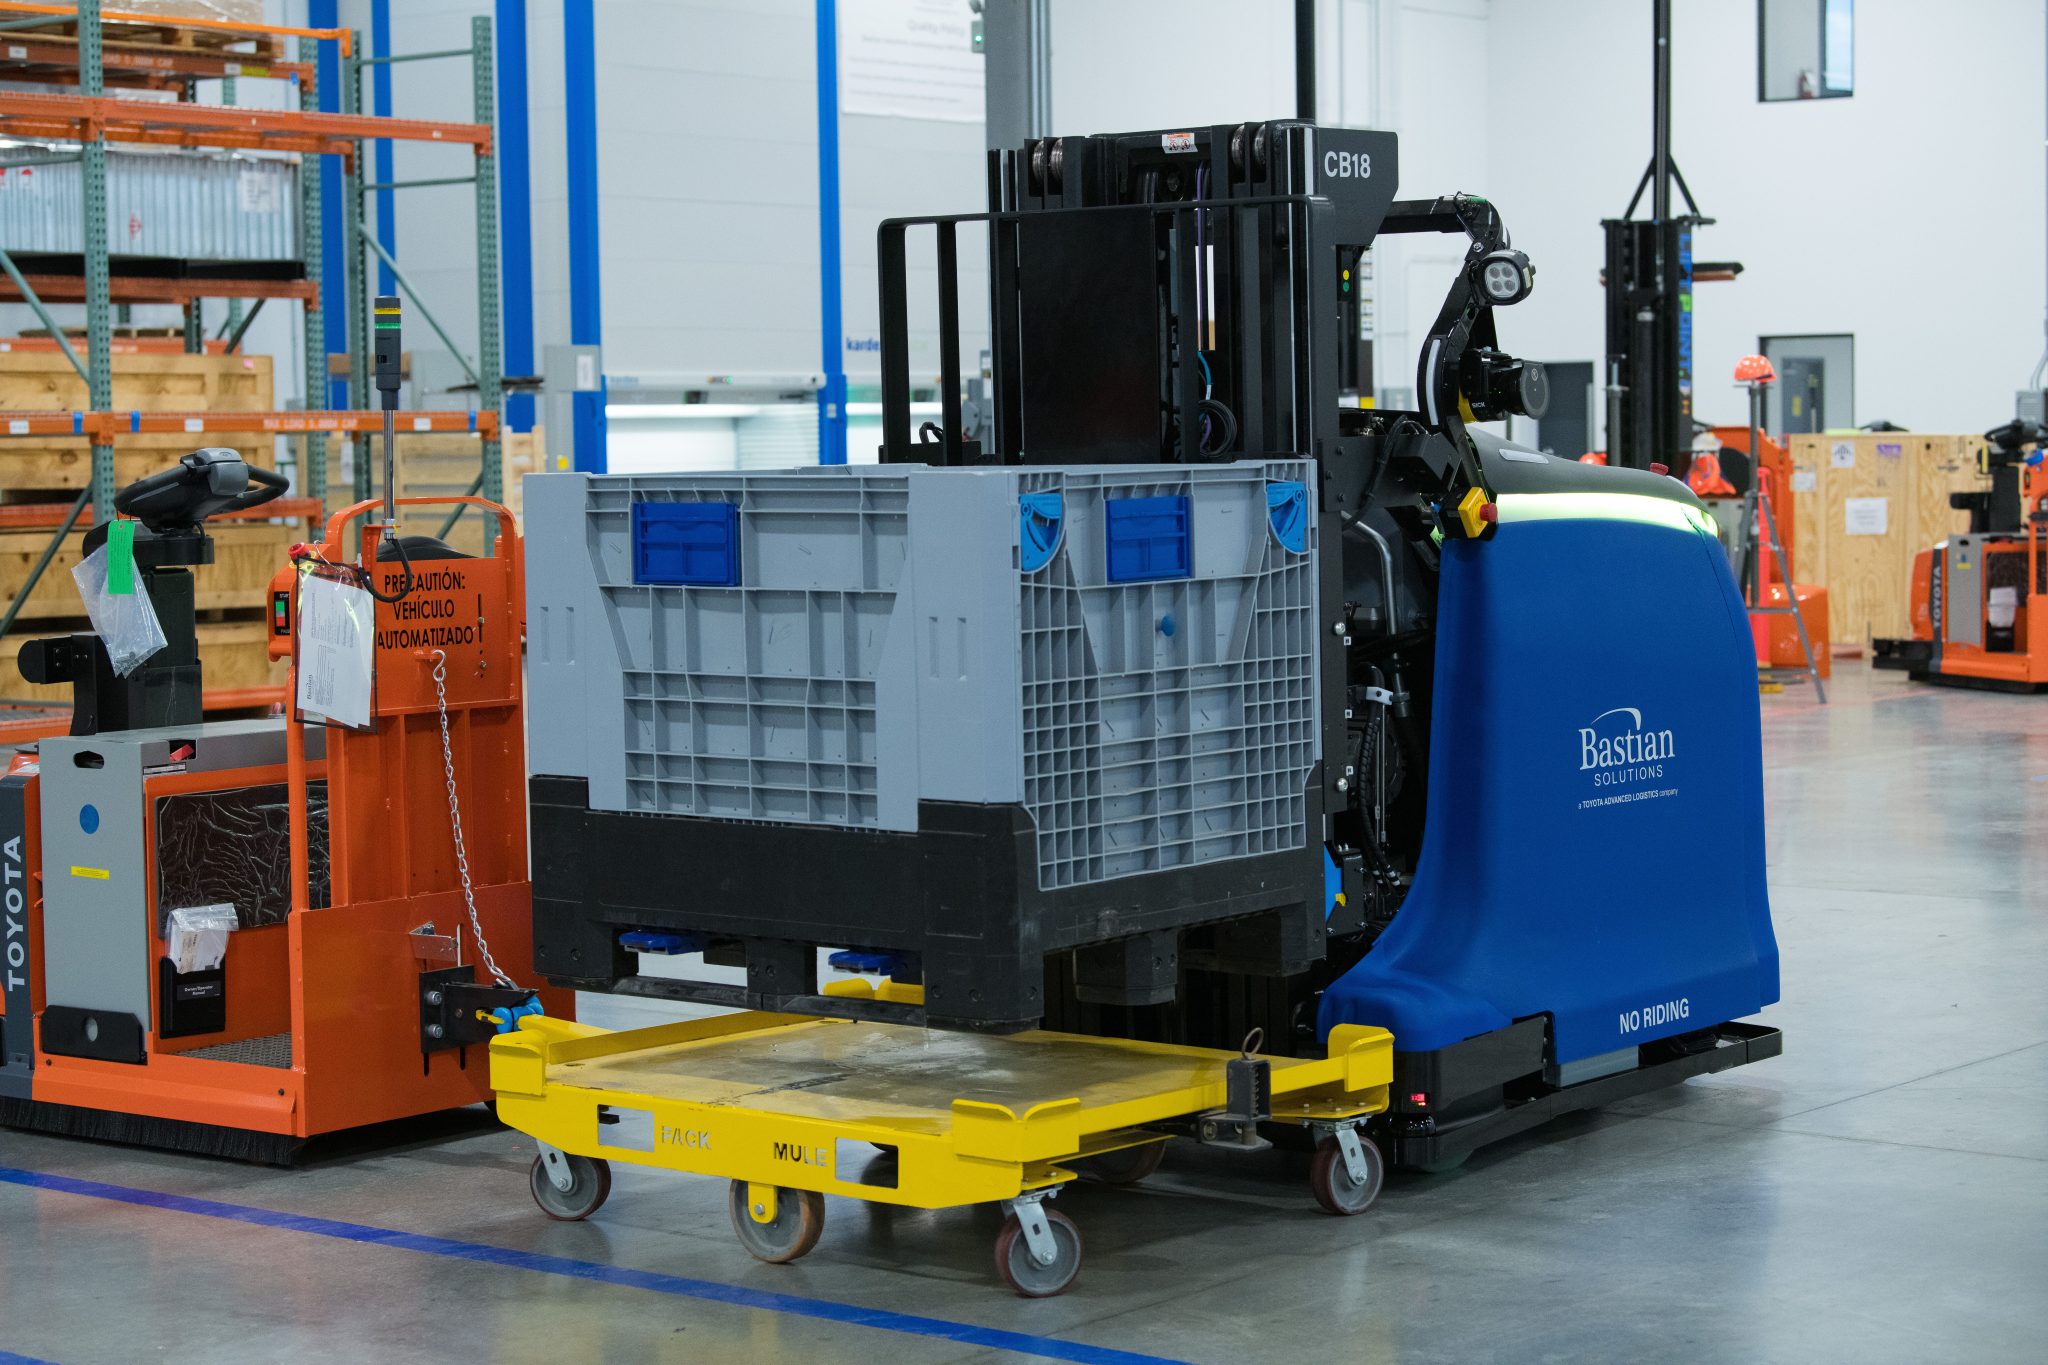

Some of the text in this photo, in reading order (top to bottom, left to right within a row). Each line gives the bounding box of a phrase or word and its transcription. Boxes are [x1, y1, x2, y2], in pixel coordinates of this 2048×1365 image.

[1324, 150, 1371, 179] CB18
[845, 336, 881, 352] karde
[1471, 401, 1486, 409] SICK
[392, 595, 455, 620] VEHÍCULO
[1932, 565, 1941, 629] TOYOTA
[377, 625, 474, 650] AUTOMATIZADO
[1578, 728, 1676, 771] Bastian
[1594, 764, 1663, 787] SOLUTIONS
[1582, 798, 1604, 809] TOYOTA
[1604, 794, 1632, 805] ADVANCED
[1632, 789, 1659, 801] LOGISTICS
[1659, 788, 1679, 797] company
[3, 835, 26, 992] TOYOTA
[1619, 997, 1689, 1035] NO RIDING
[773, 1141, 828, 1167] MULE
